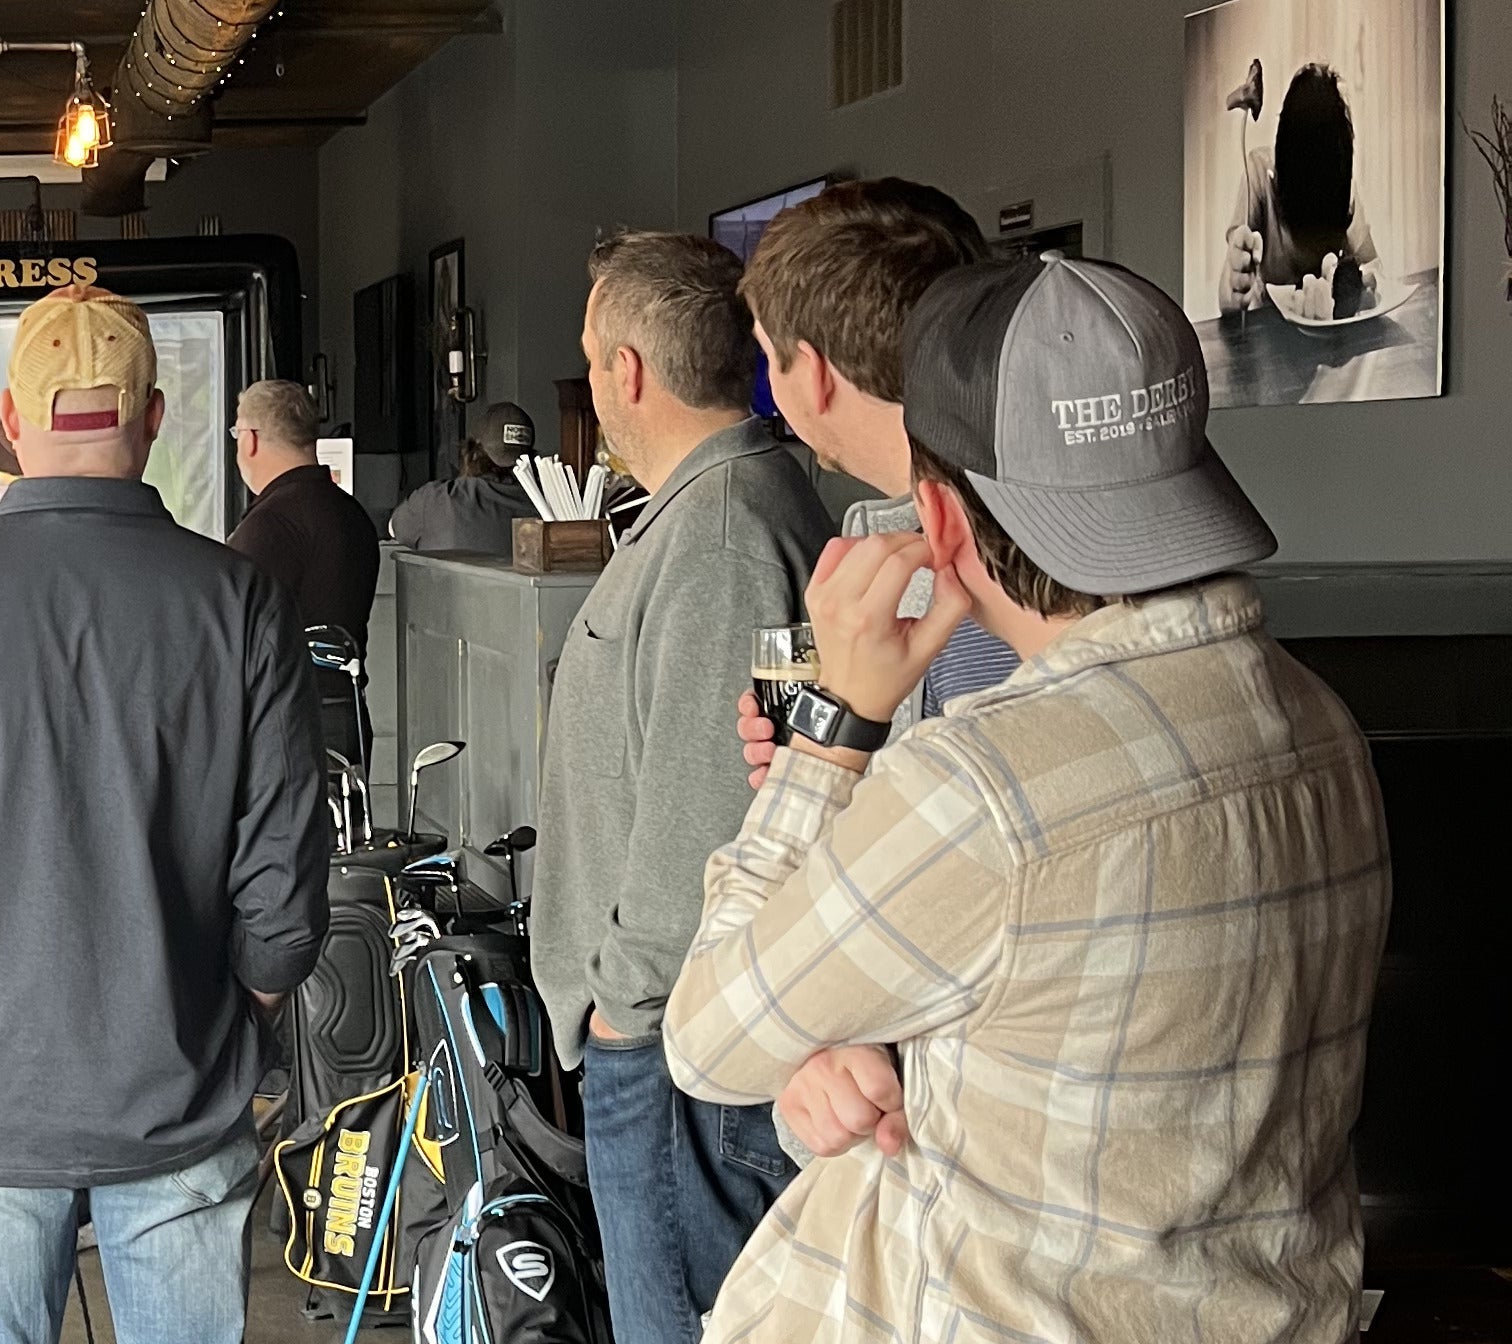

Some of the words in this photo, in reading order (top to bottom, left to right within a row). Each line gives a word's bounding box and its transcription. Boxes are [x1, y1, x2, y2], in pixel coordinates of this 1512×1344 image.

[1051, 394, 1122, 429] THE
[1130, 367, 1196, 419] DERBY
[1064, 428, 1097, 445] EST.
[324, 1128, 372, 1257] BRUINS
[357, 1165, 380, 1230] BOSTON
